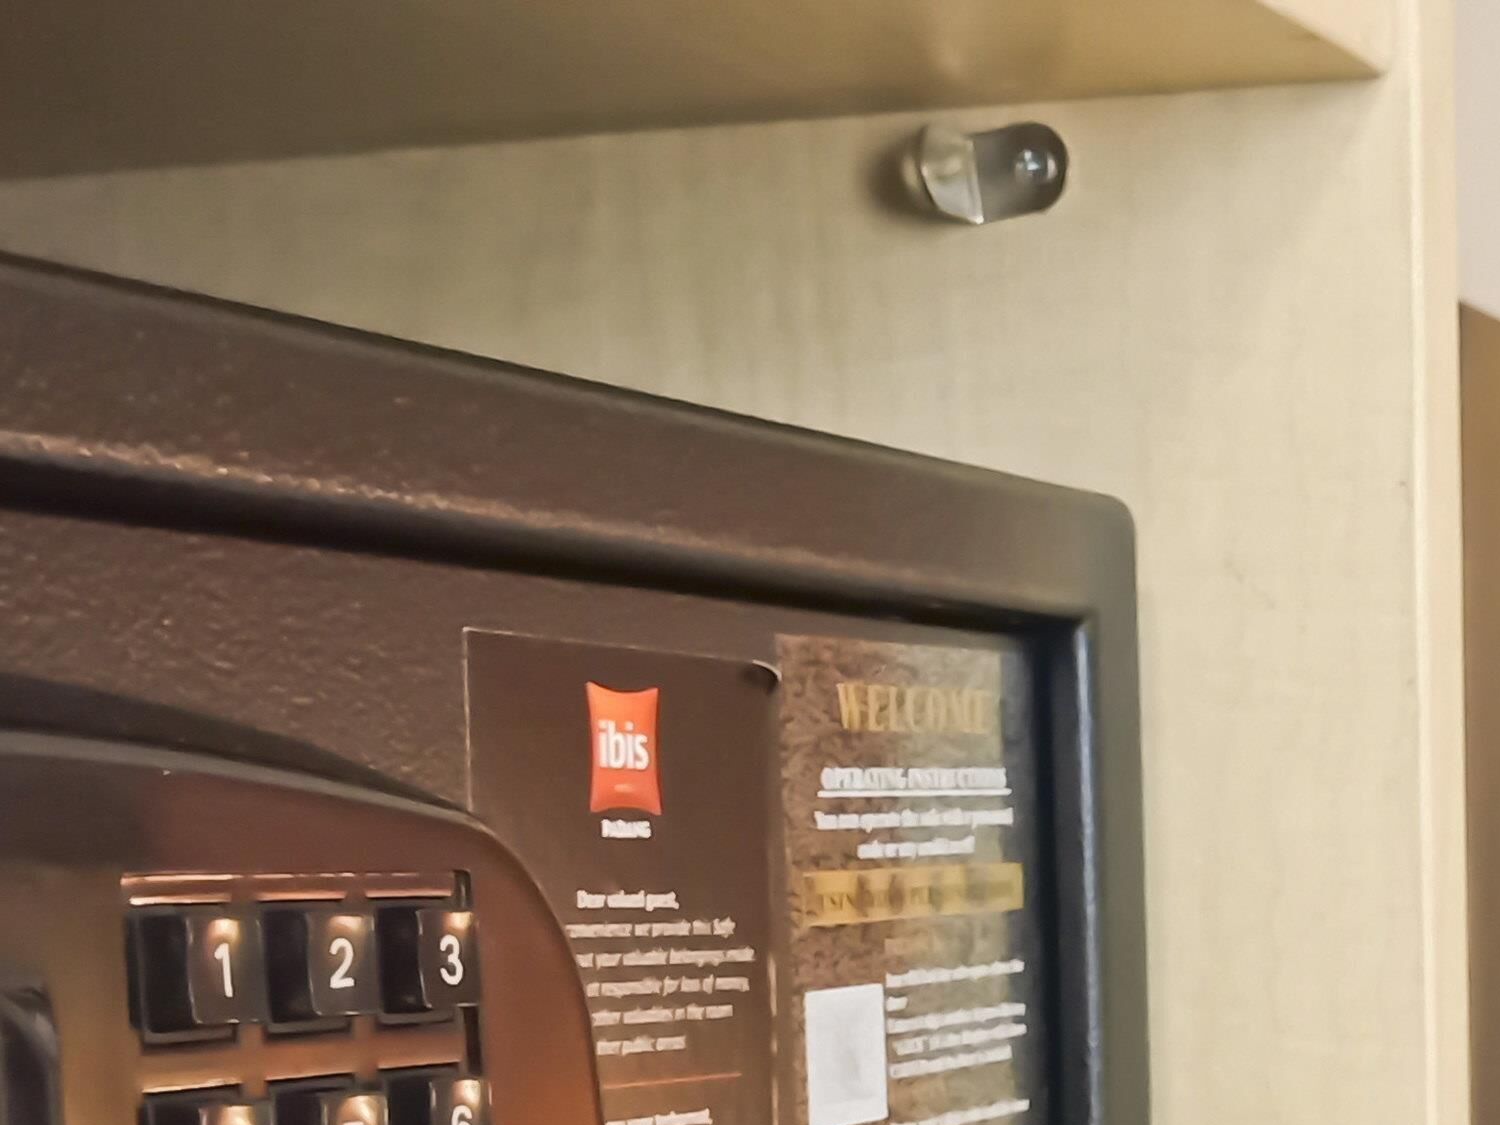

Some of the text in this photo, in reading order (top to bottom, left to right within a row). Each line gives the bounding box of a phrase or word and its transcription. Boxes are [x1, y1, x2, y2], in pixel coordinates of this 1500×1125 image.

[598, 719, 649, 771] ibis
[215, 935, 464, 998] 1 2 3
